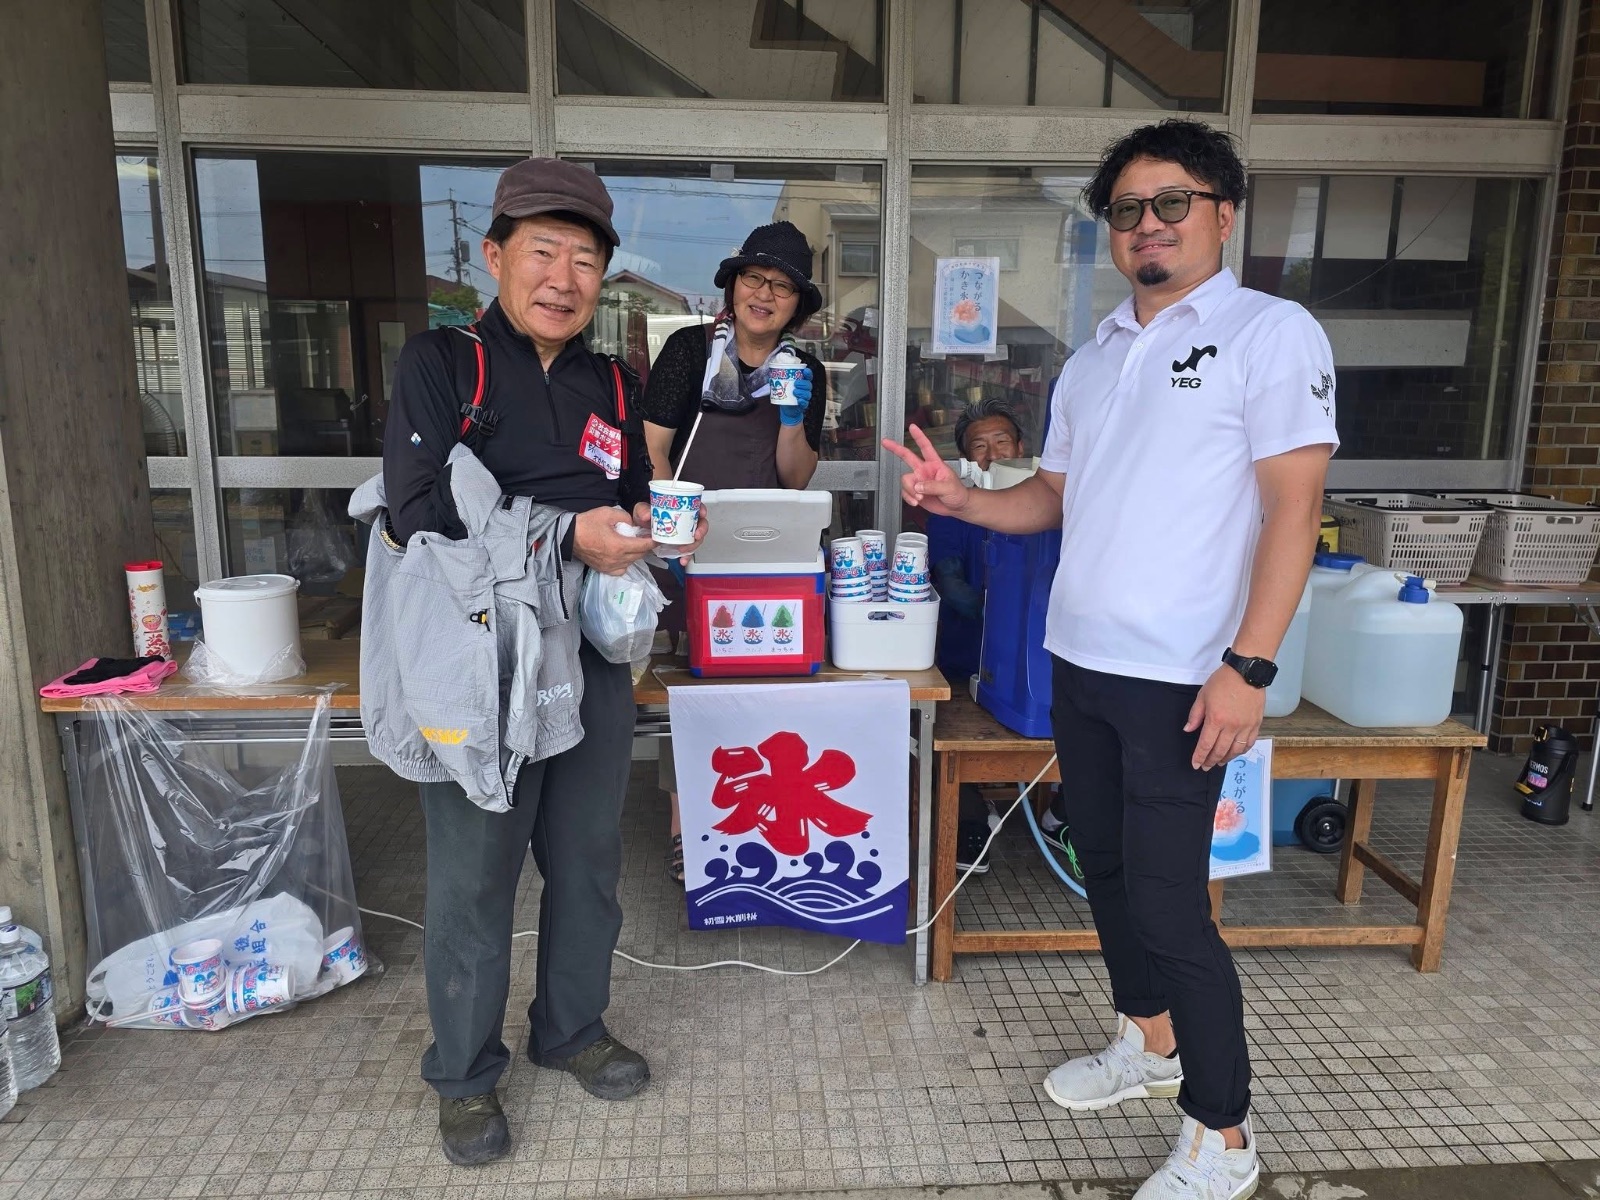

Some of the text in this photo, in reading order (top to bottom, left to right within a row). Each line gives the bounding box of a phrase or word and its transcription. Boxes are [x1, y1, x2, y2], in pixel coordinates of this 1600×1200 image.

[960, 271, 969, 300] かき氷
[974, 272, 983, 311] つながる
[1171, 378, 1201, 388] YEG
[716, 629, 730, 638] 氷
[746, 629, 760, 638] 氷
[776, 629, 790, 638] 氷
[711, 731, 874, 856] 氷
[1233, 759, 1247, 813] つながる
